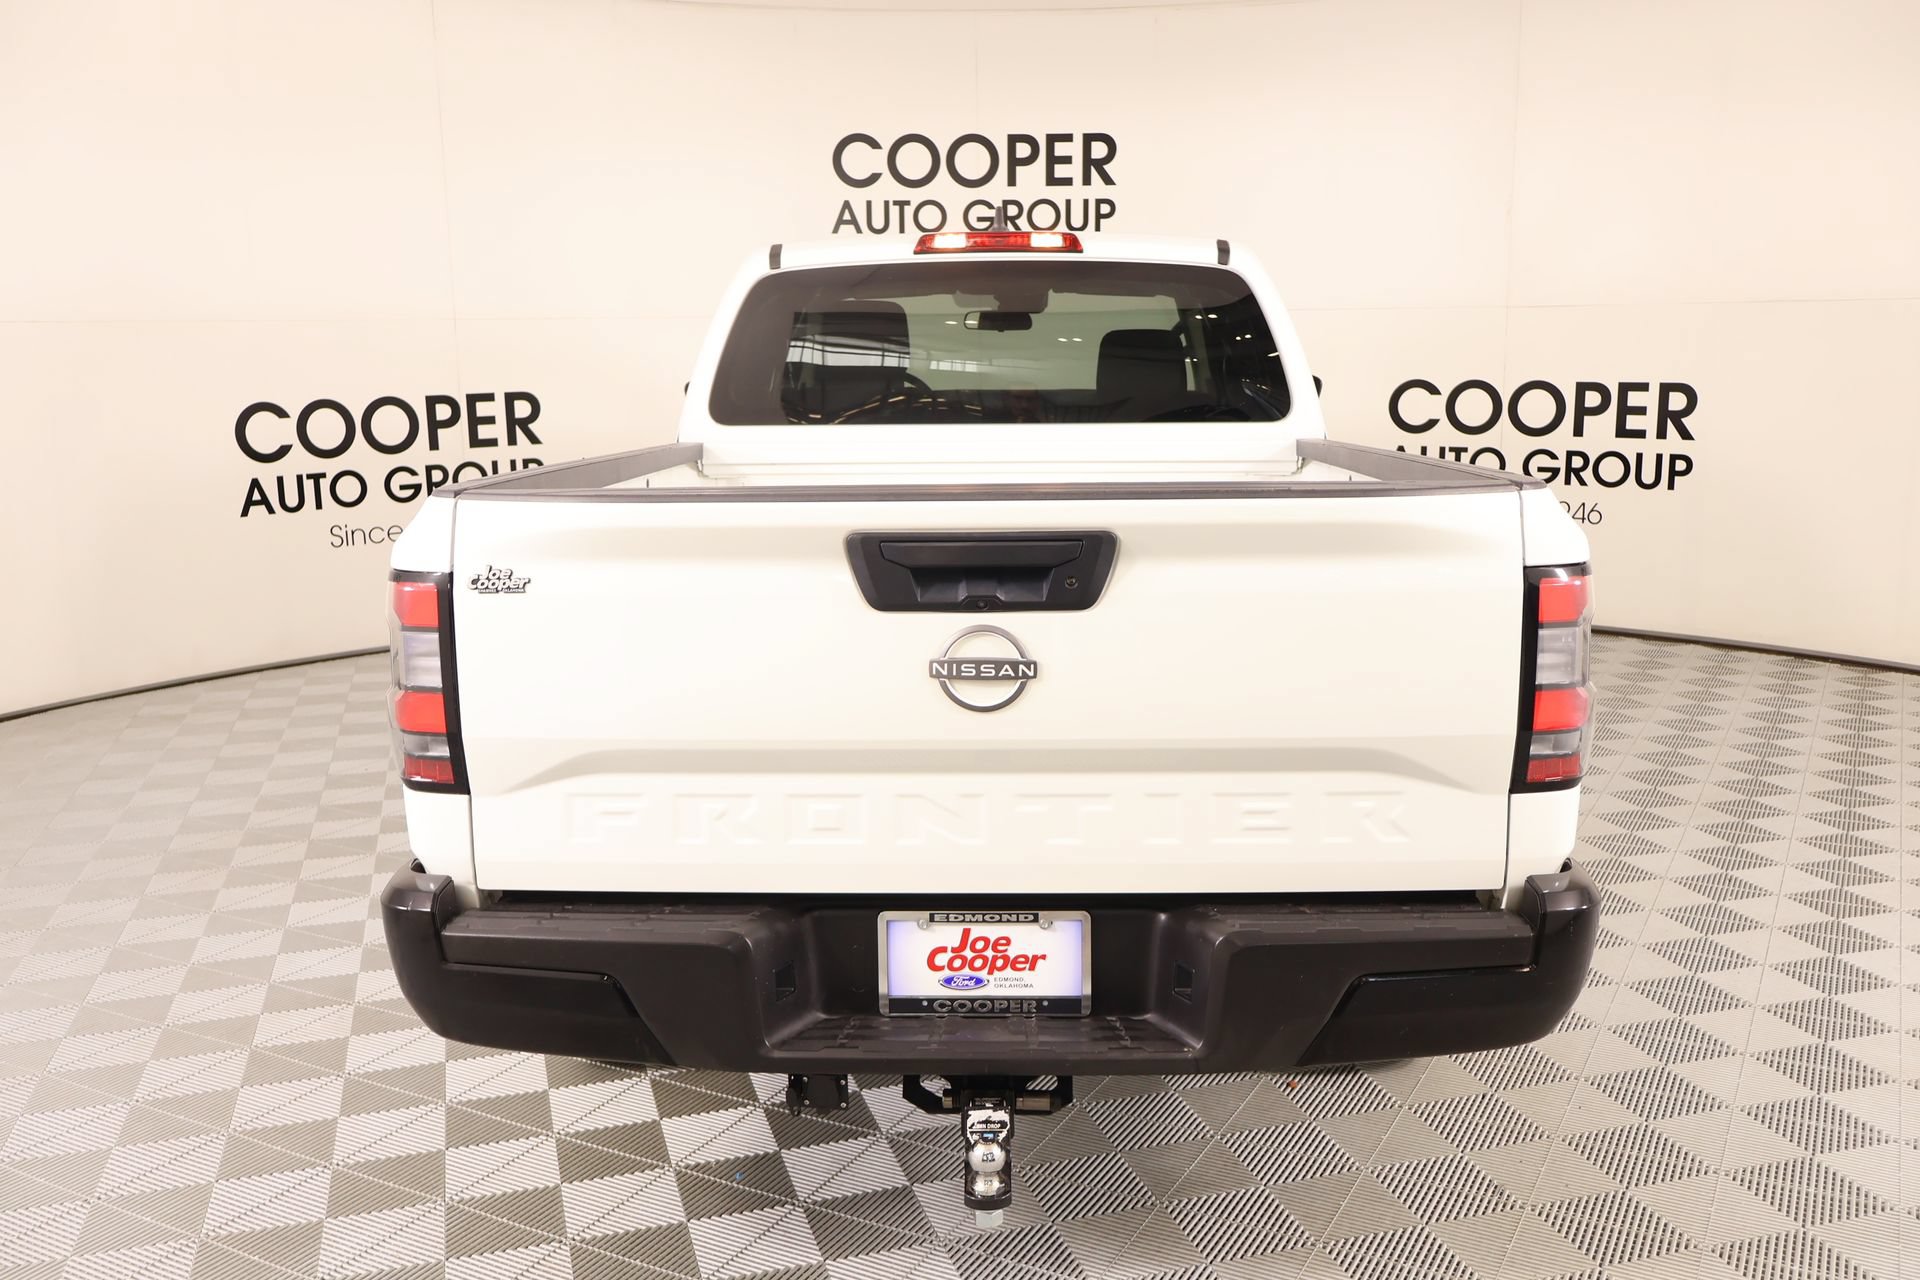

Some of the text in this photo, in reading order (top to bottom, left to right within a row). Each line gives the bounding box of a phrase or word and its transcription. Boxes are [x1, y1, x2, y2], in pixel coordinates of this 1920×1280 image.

[832, 133, 1117, 188] COOPER
[832, 198, 1117, 235] AUTO GROUP
[1388, 379, 1698, 441] COOPER
[234, 391, 543, 464] COOPER
[1522, 448, 1694, 491] GROUP
[240, 470, 368, 517] AUTO
[330, 524, 403, 548] Since
[467, 577, 531, 593] Cooper
[474, 564, 513, 580] Joe
[933, 663, 1035, 677] NISSAN
[562, 791, 1415, 846] FRONTIER
[934, 914, 1034, 922] EDMOND
[951, 928, 1012, 953] Joe
[927, 946, 1046, 975] Cooper
[951, 976, 976, 986] Ford
[933, 1000, 1037, 1013] COOPER
